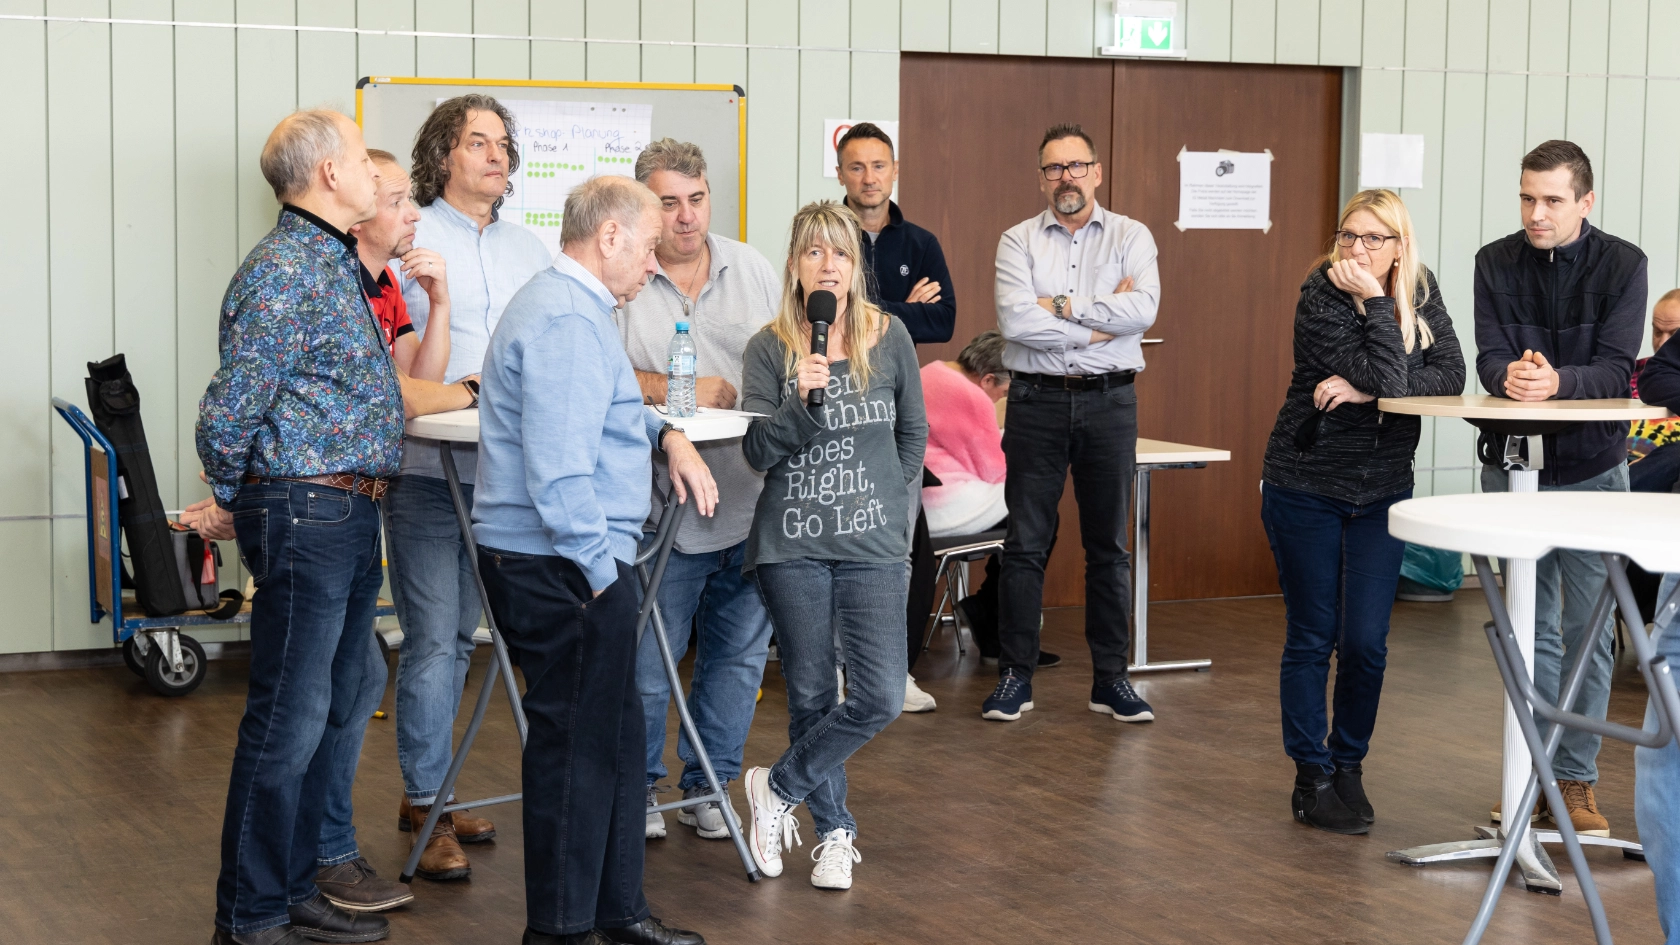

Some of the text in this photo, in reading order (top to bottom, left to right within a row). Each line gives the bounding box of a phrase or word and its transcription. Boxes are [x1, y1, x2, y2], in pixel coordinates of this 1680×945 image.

[533, 141, 569, 152] Phase 1
[571, 124, 624, 144] Planung
[605, 141, 642, 153] Phase 2
[787, 436, 855, 469] Goes
[783, 460, 875, 506] Right,
[782, 498, 888, 539] Go Left
